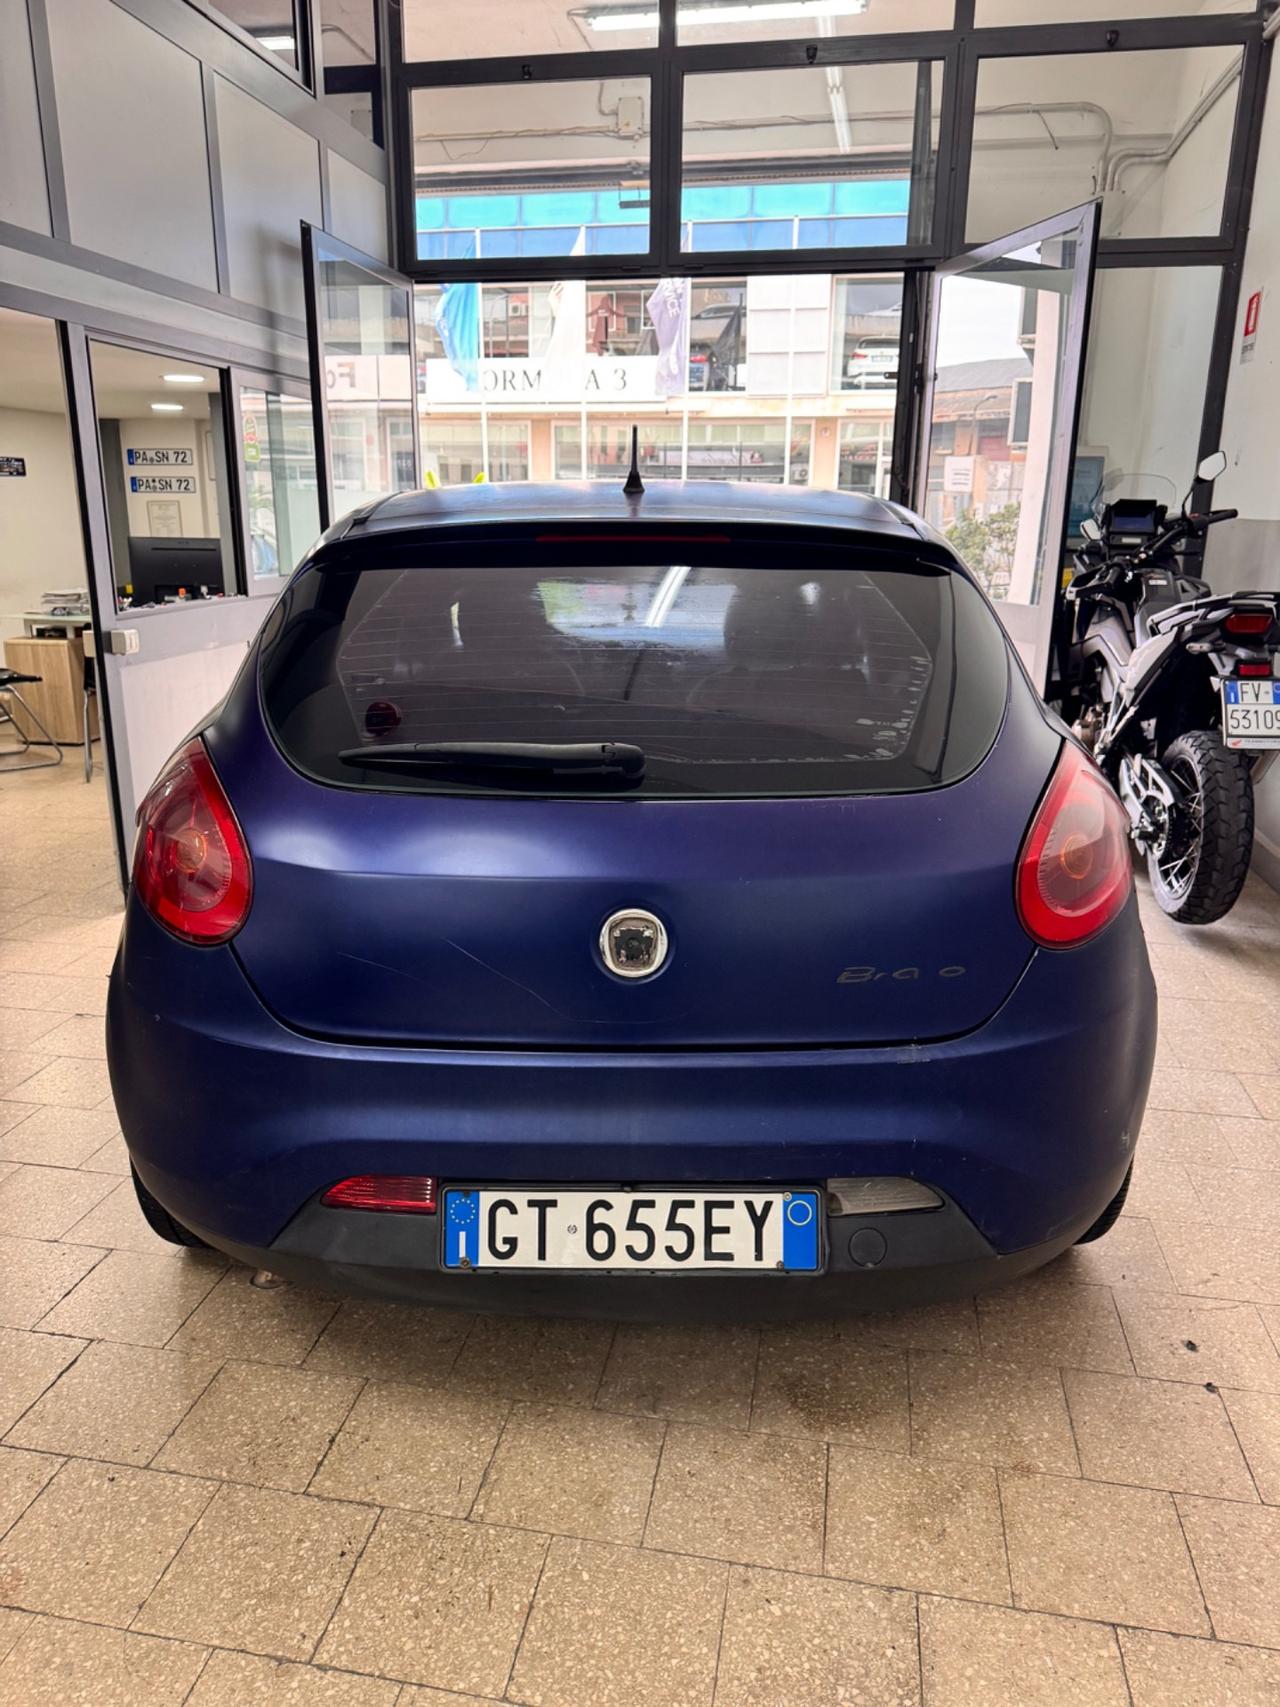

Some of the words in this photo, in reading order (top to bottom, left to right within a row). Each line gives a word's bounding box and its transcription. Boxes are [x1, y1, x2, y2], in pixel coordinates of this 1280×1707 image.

[614, 368, 628, 390] 3
[134, 451, 148, 463] PA
[155, 451, 169, 463] SN
[173, 451, 187, 463] 72
[138, 479, 151, 490] PA
[158, 479, 172, 490] SN
[176, 479, 190, 490] 72
[488, 1199, 558, 1260] GT
[585, 1199, 774, 1261] 655EY
